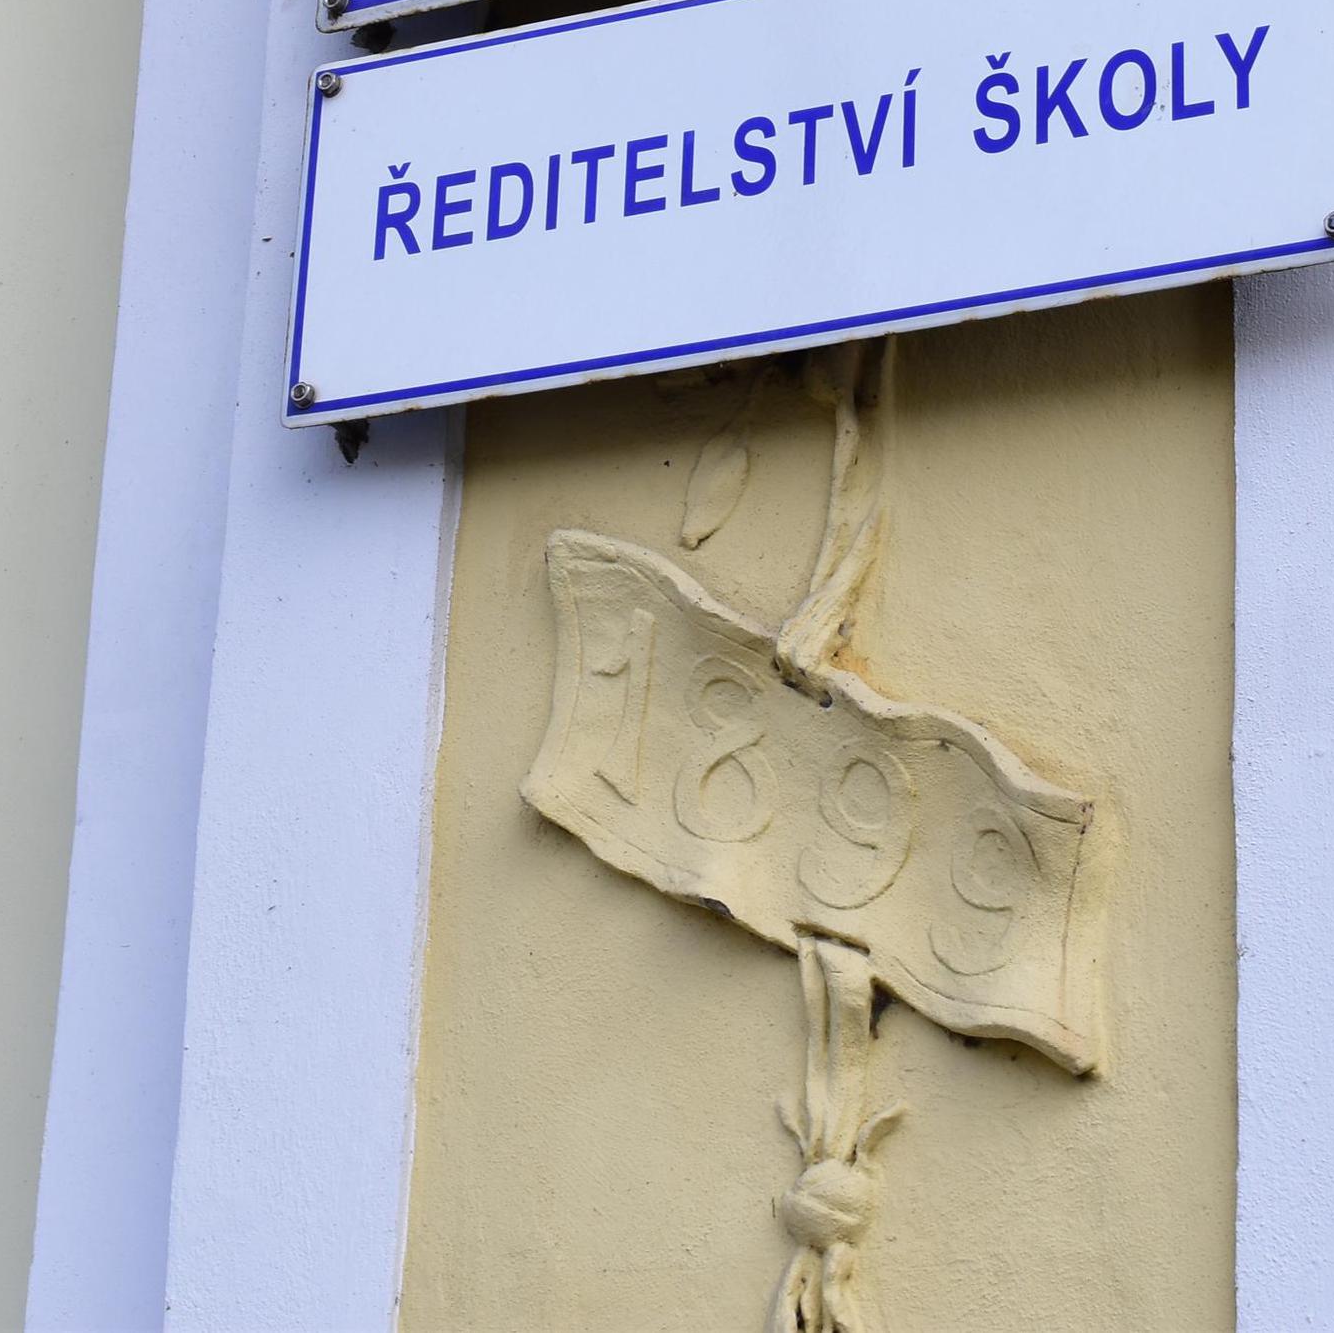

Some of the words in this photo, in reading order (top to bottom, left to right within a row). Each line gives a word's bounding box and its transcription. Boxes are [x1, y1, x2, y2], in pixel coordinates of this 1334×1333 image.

[373, 67, 922, 261] ŘEDITELSTVÍ
[972, 24, 1270, 155] ŠKOLY
[589, 605, 1041, 977] 1899
